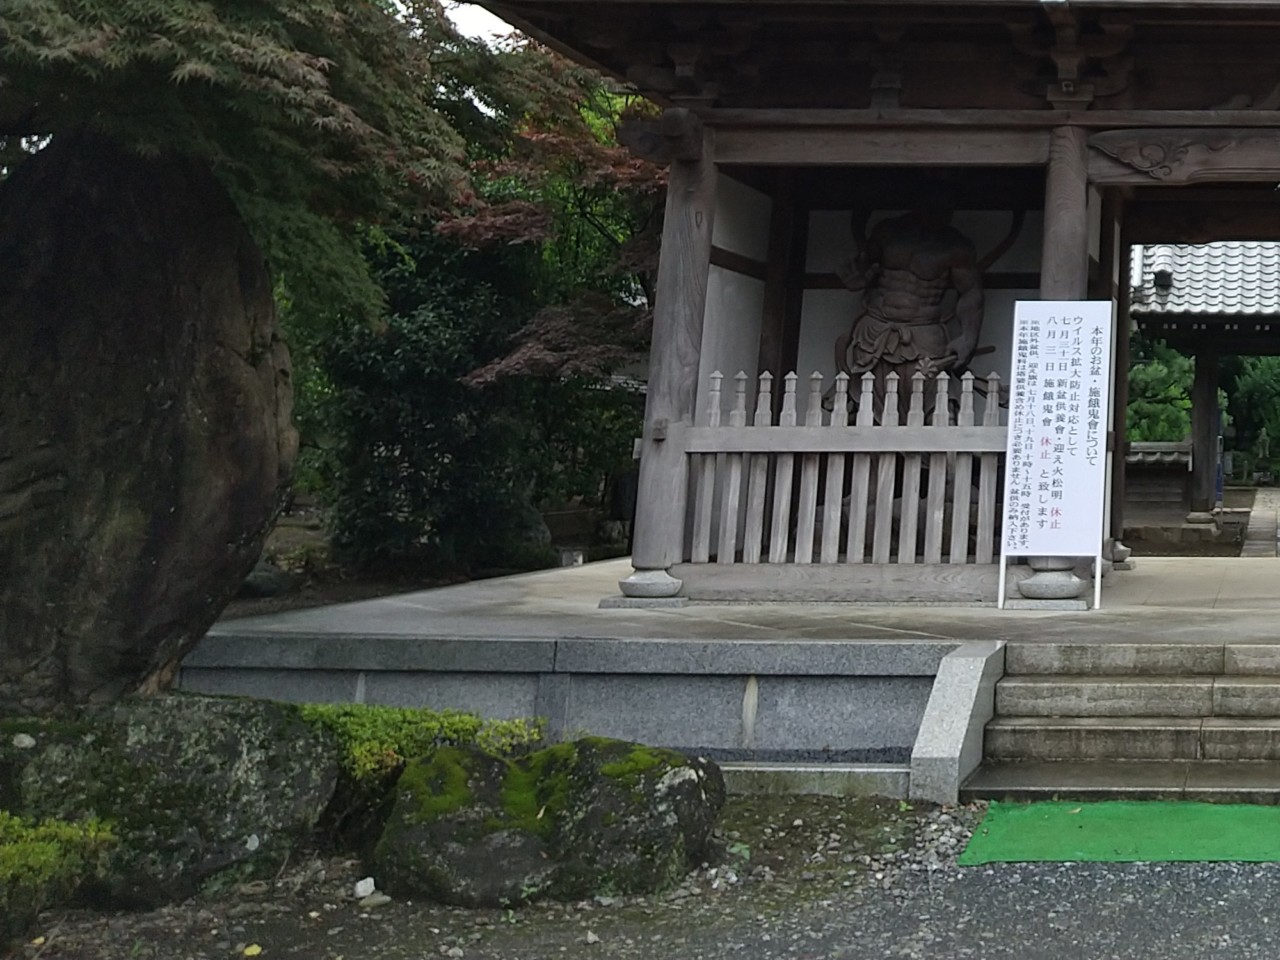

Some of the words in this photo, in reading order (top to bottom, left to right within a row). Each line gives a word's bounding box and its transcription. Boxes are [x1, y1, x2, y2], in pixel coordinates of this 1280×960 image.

[1067, 316, 1083, 456] ウイルス拡大防止対応として
